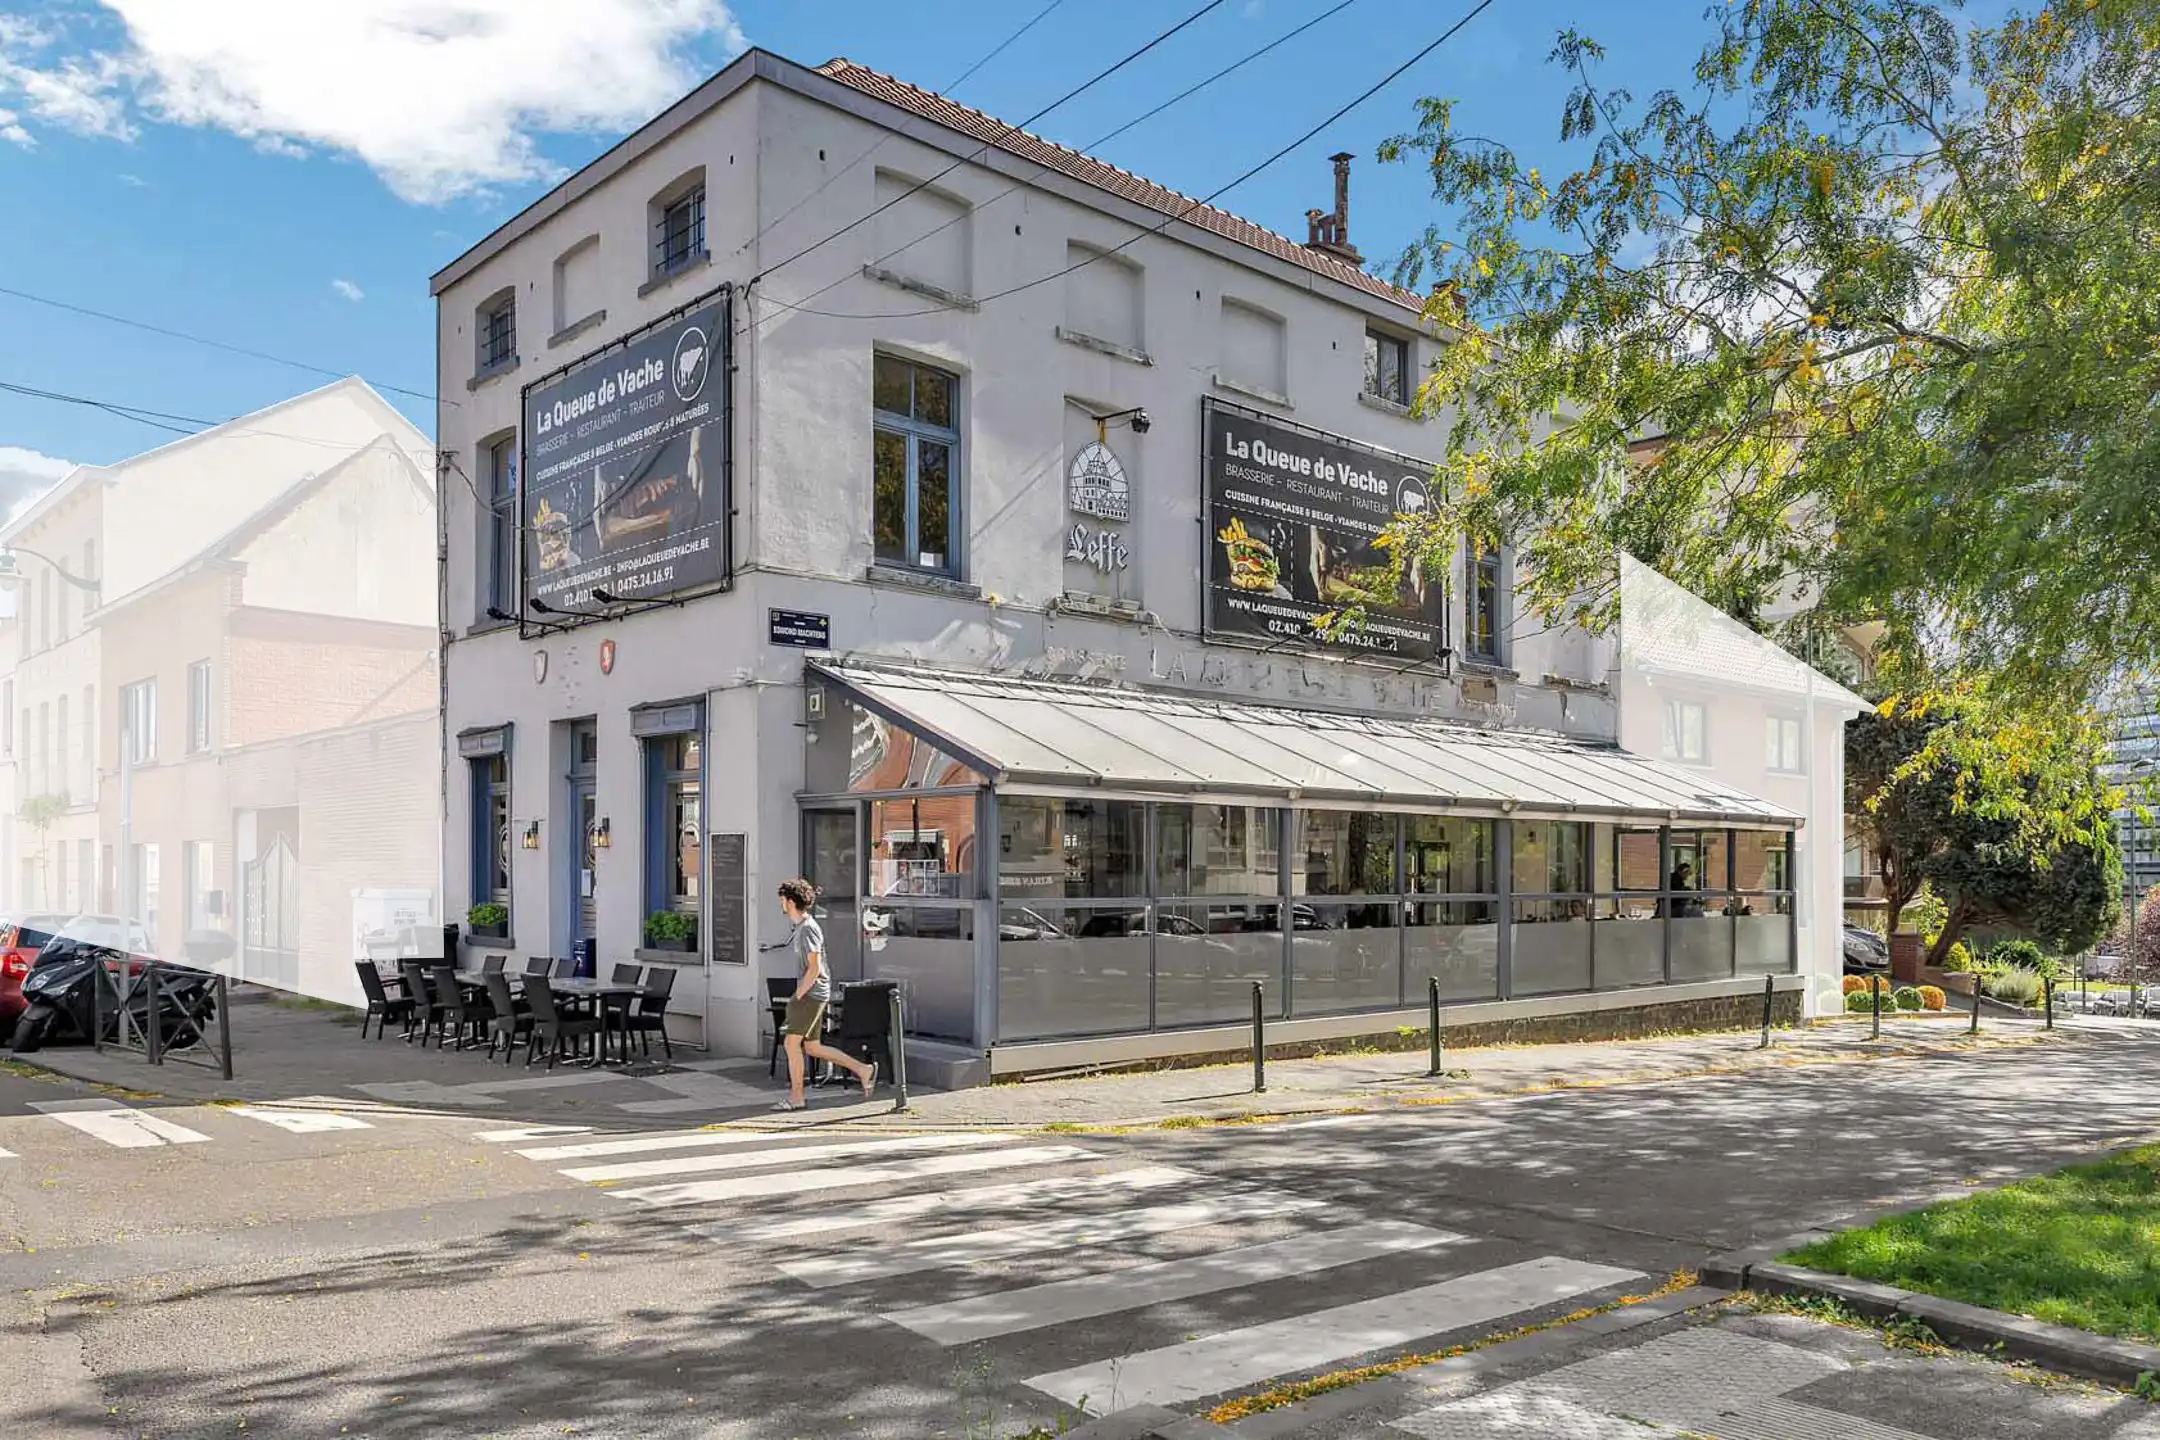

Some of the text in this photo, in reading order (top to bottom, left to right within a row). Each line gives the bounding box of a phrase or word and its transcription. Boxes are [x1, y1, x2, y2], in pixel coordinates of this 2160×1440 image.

[536, 358, 664, 435] La Queue de Vache
[628, 390, 665, 417] TRAITEUR
[1225, 431, 1389, 496] La Queue de Vache
[1225, 463, 1276, 487] BRASSERIE
[1286, 478, 1343, 503] RESTAURANT
[1351, 495, 1389, 514] TRAITEUR
[1225, 489, 1260, 505] CUISINE
[1260, 497, 1304, 514] FRANÇAISE
[1311, 510, 1334, 523] BELGE
[1338, 516, 1367, 531] VIANDES
[1066, 522, 1129, 573] Leffe
